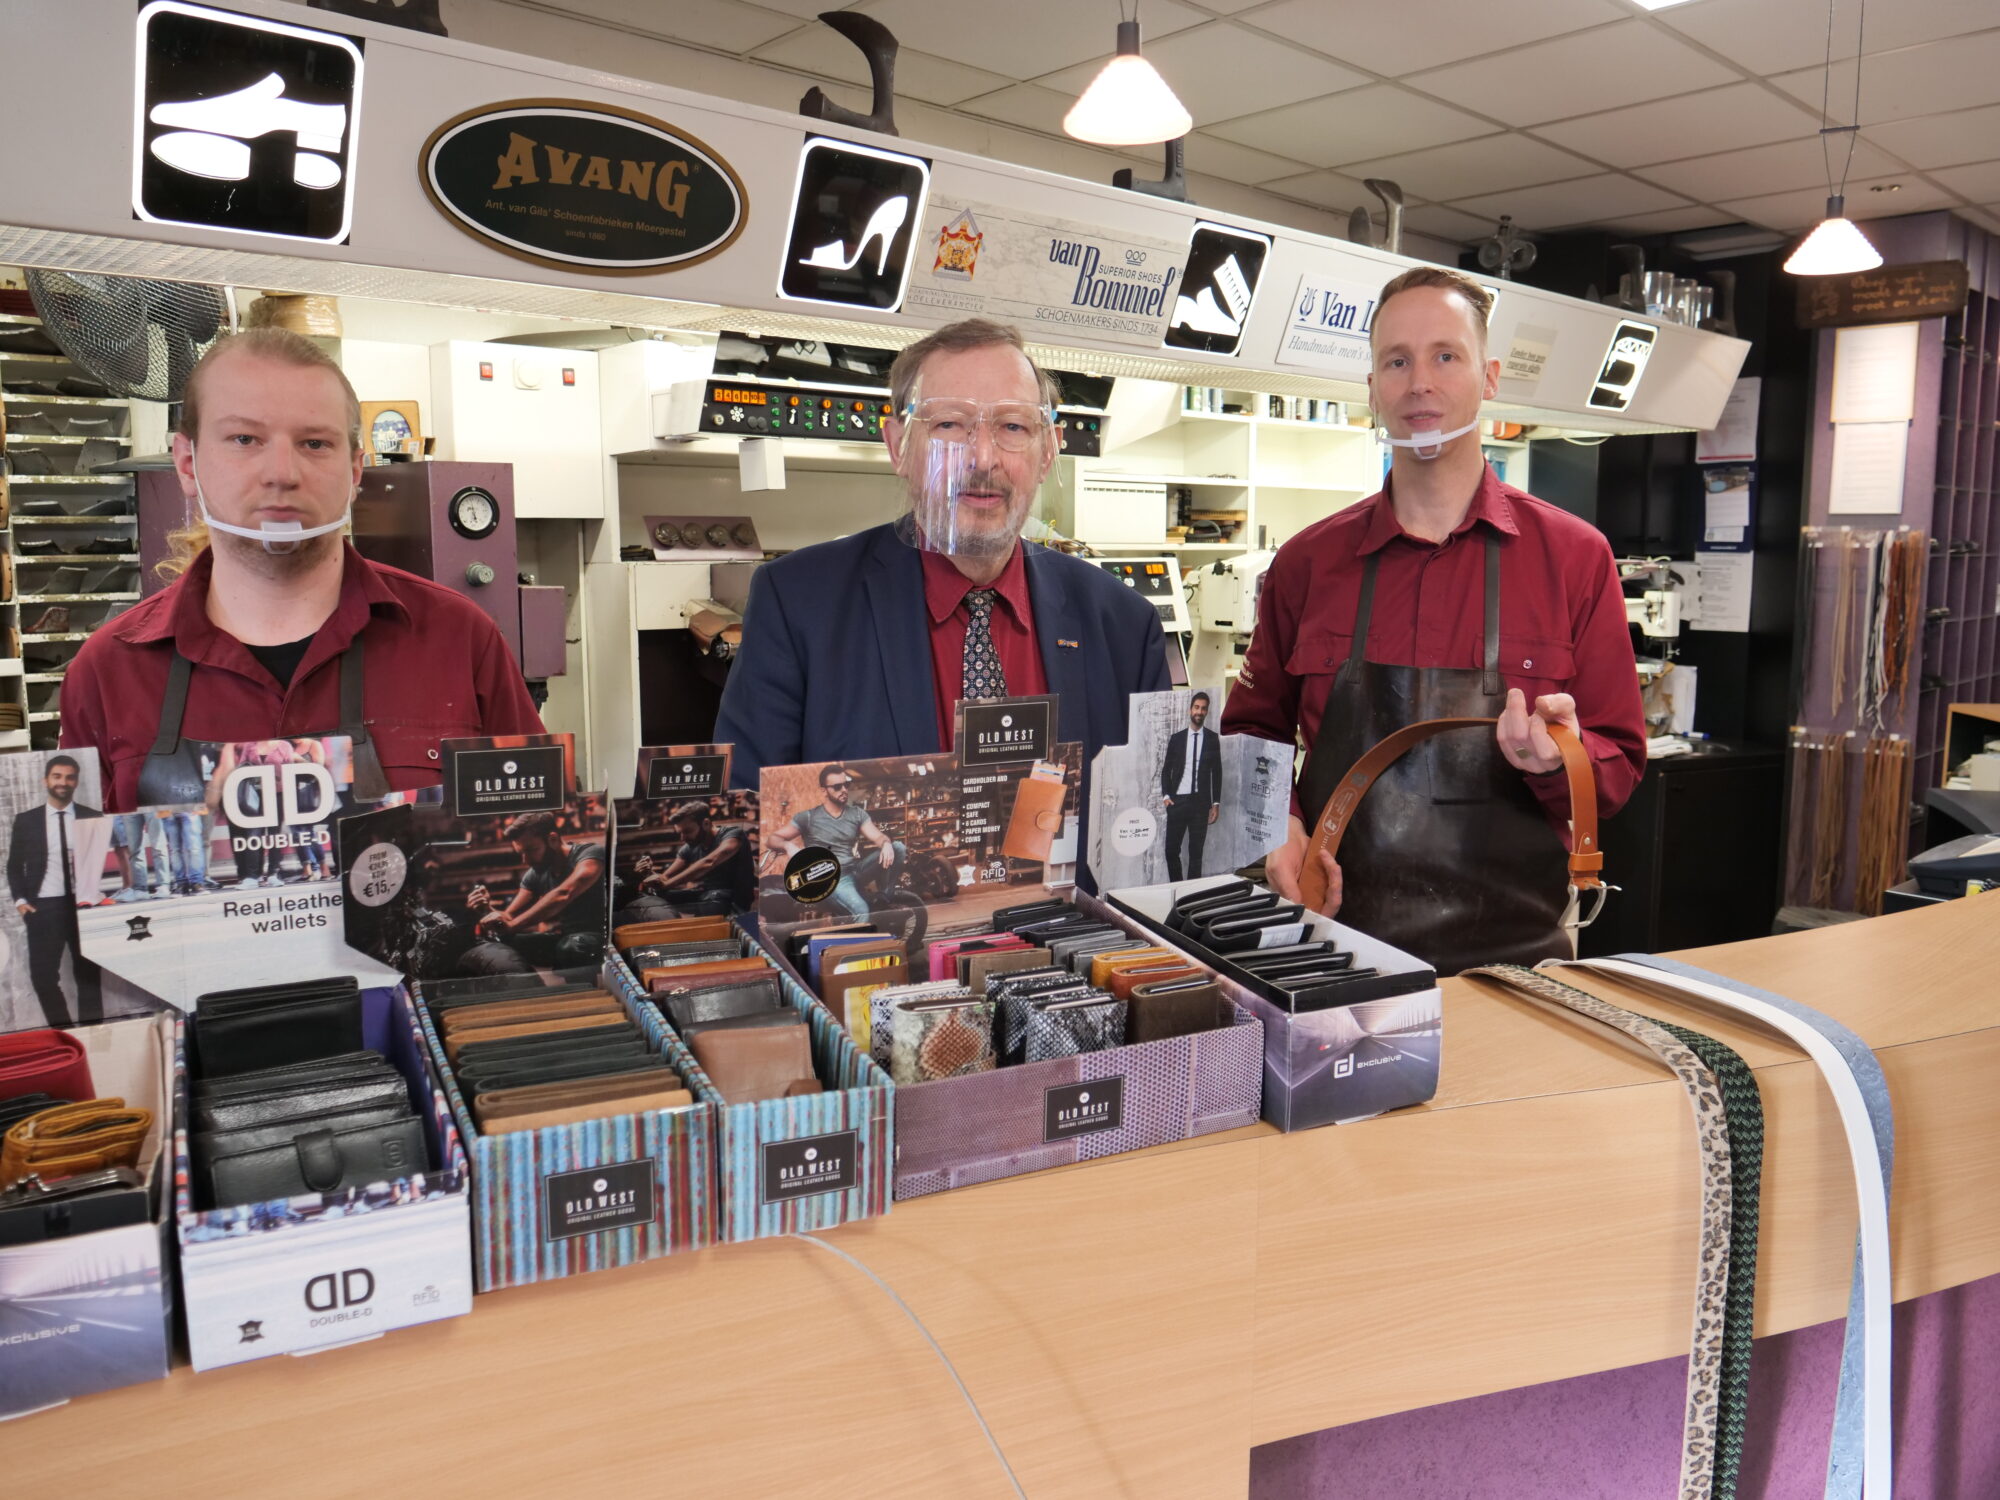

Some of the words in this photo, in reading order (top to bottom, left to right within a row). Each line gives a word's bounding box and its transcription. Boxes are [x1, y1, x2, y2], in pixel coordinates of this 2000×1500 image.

[492, 131, 691, 218] AVANG
[485, 199, 507, 211] Ant.
[509, 201, 527, 214] van
[553, 208, 634, 230] Schoenfabrieken
[635, 220, 687, 238] Moergestel
[1049, 238, 1083, 267] van
[1071, 245, 1176, 318] Bommel
[1098, 264, 1136, 280] SUPERIOR
[1137, 270, 1162, 284] SHOES
[1320, 290, 1357, 330] Van
[1035, 307, 1111, 328] SCHOENMAKERS
[1112, 318, 1138, 332] SINDS
[1140, 322, 1158, 334] 1734
[1288, 335, 1338, 357] Handmade
[979, 732, 1000, 744] OLD
[1004, 729, 1034, 742] WEST
[475, 779, 502, 792] OLD
[508, 776, 545, 790] WEST
[661, 775, 681, 784] OLD
[684, 773, 711, 783] WEST
[963, 775, 997, 785] CARDHOLDER
[1251, 782, 1271, 795] RFID
[963, 785, 983, 794] WALLET
[966, 801, 991, 810] COMPACT
[966, 811, 979, 819] SAFE
[970, 818, 987, 827] CARDS
[982, 825, 1001, 833] MONEY
[233, 830, 331, 852] DOUBLE-D
[981, 868, 1006, 879] RFID
[223, 898, 271, 917] Real
[278, 892, 343, 912] leathe
[251, 912, 327, 933] wallets
[1356, 1054, 1402, 1069] exclusive
[1058, 1107, 1078, 1121] OLD
[1082, 1101, 1109, 1116] WEST
[780, 1164, 804, 1180] OLD
[808, 1158, 841, 1175] WEST
[566, 1198, 593, 1215] OLD
[598, 1190, 635, 1208] WEST
[310, 1307, 373, 1329] DOUBLE-D
[0, 1324, 81, 1347] xclusive
